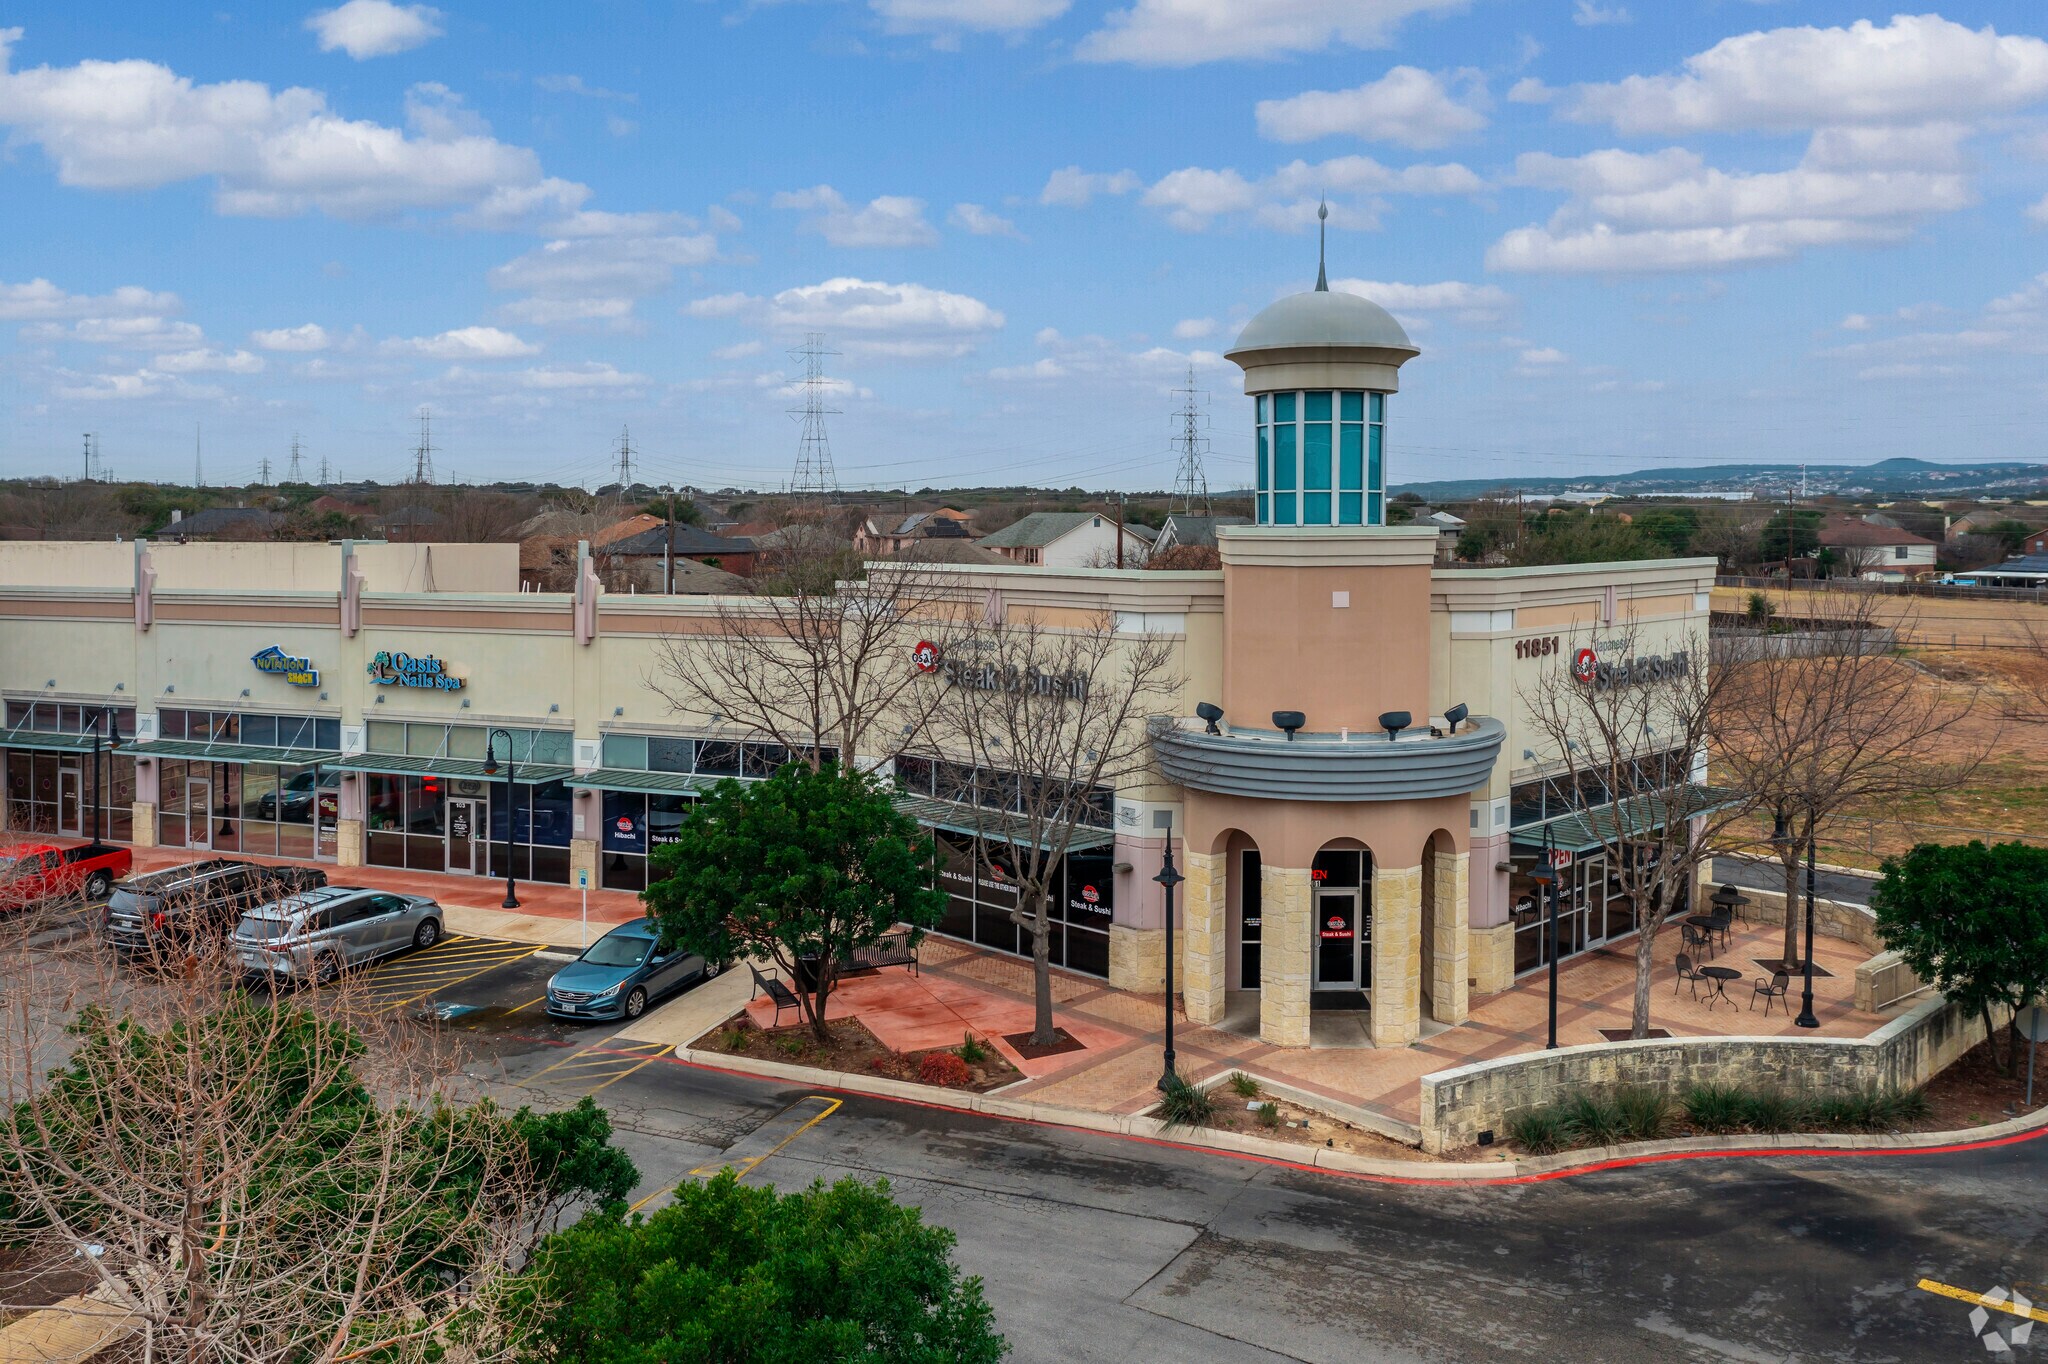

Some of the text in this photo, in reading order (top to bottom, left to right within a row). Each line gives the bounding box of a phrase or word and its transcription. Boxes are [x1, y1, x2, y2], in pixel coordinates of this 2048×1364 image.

[1515, 636, 1559, 659] 11851
[391, 652, 442, 673] Oasis
[287, 672, 313, 684] SHACK
[399, 673, 462, 692] Nails Spa
[614, 832, 636, 840] Hibachi
[652, 835, 668, 843] Steak
[1070, 899, 1111, 916] Steak & Sushi
[1515, 901, 1532, 912] Hibachi
